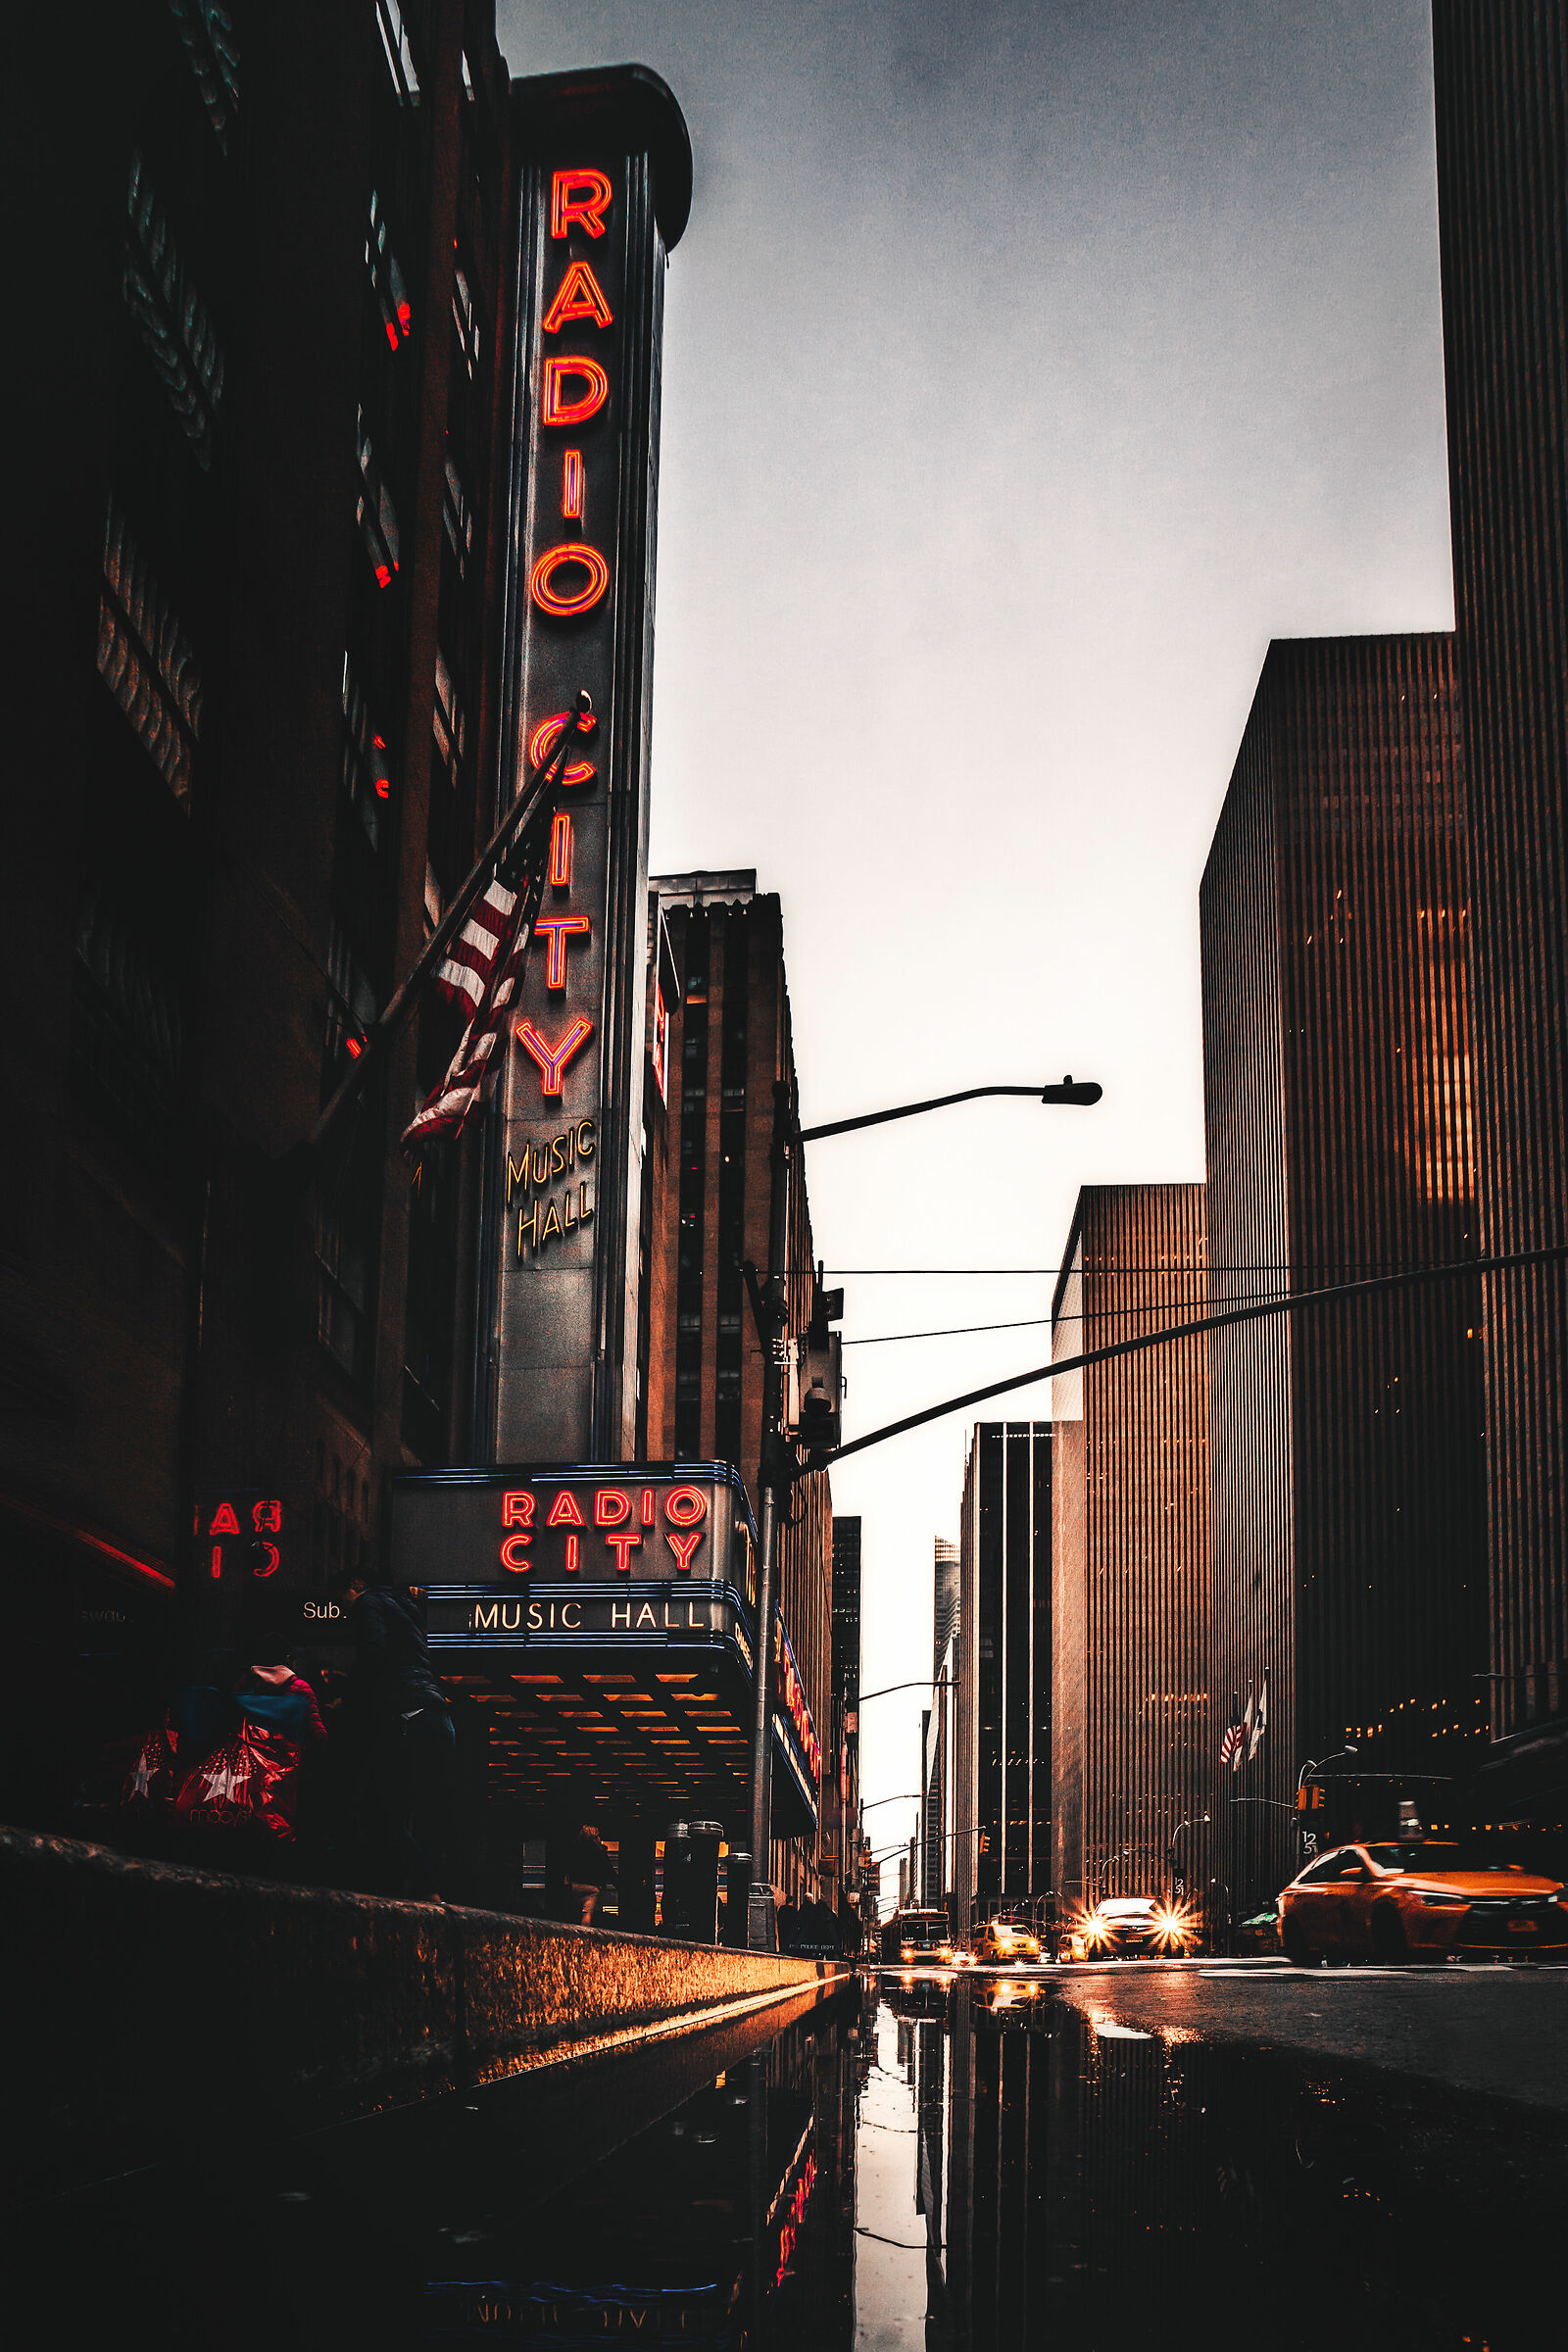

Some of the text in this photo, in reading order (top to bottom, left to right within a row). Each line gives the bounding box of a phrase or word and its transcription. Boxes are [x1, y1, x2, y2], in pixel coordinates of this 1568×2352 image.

[515, 169, 612, 1097] RADIO CITY
[506, 1120, 594, 1203] MUSIC
[516, 1182, 593, 1257] HALL
[502, 1485, 707, 1528] RADIO
[500, 1532, 704, 1573] CITY
[473, 1601, 705, 1630] MUSIC HALL
